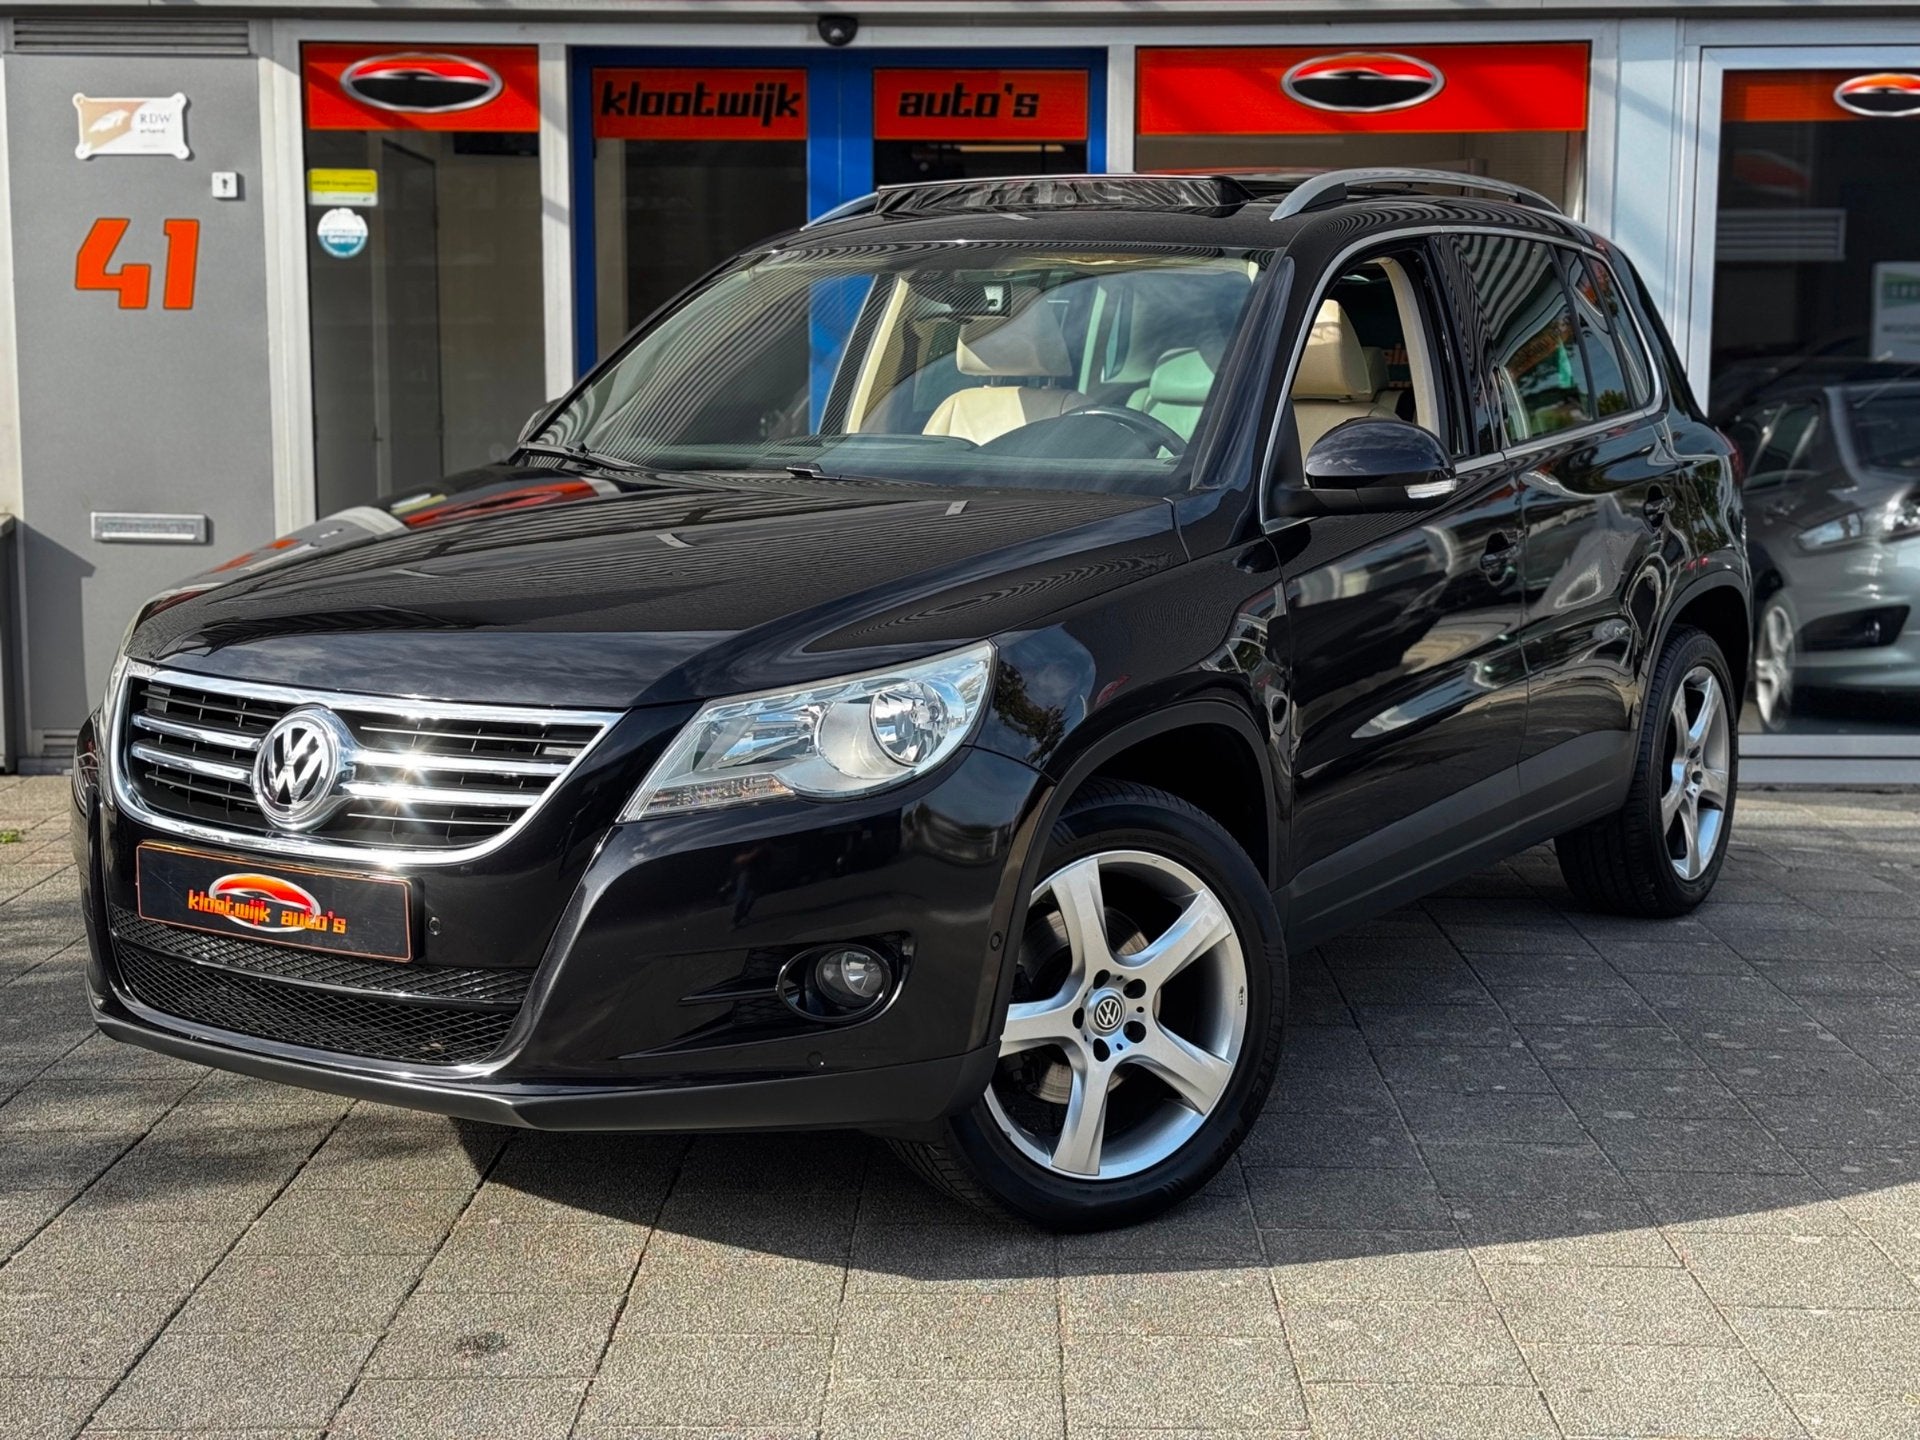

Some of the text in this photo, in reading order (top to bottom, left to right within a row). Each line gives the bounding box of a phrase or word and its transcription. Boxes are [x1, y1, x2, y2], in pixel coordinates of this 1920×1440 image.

[140, 112, 172, 124] RDW
[601, 80, 1041, 128] klootwijk auto's
[75, 217, 201, 310] 41
[188, 889, 346, 934] klootwijk auto's
